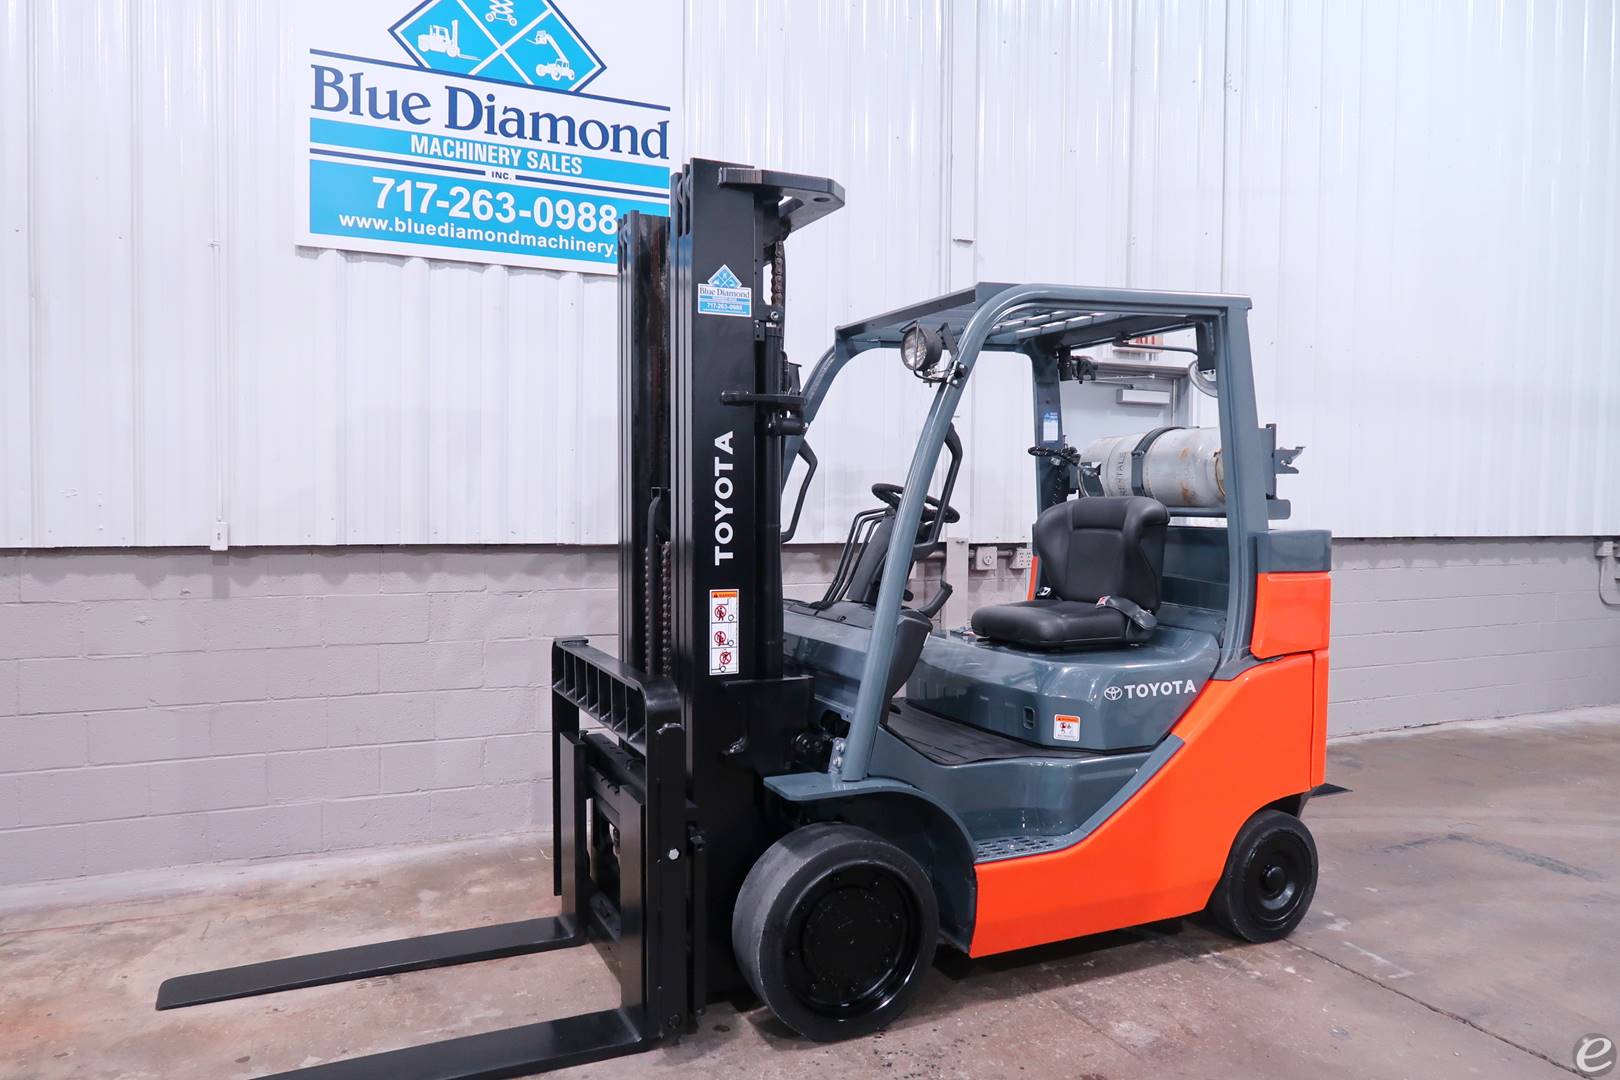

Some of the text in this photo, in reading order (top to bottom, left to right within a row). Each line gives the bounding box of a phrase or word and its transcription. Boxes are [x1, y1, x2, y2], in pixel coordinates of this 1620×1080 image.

[310, 64, 670, 160] Blue Diamond
[410, 134, 583, 175] MACHINERY SALES
[491, 170, 513, 181] INC.
[372, 176, 618, 235] 717-263-0988
[700, 287, 750, 298] Blue Diamond
[714, 430, 734, 566] TOYOTA
[1123, 679, 1197, 699] TOYOTA
